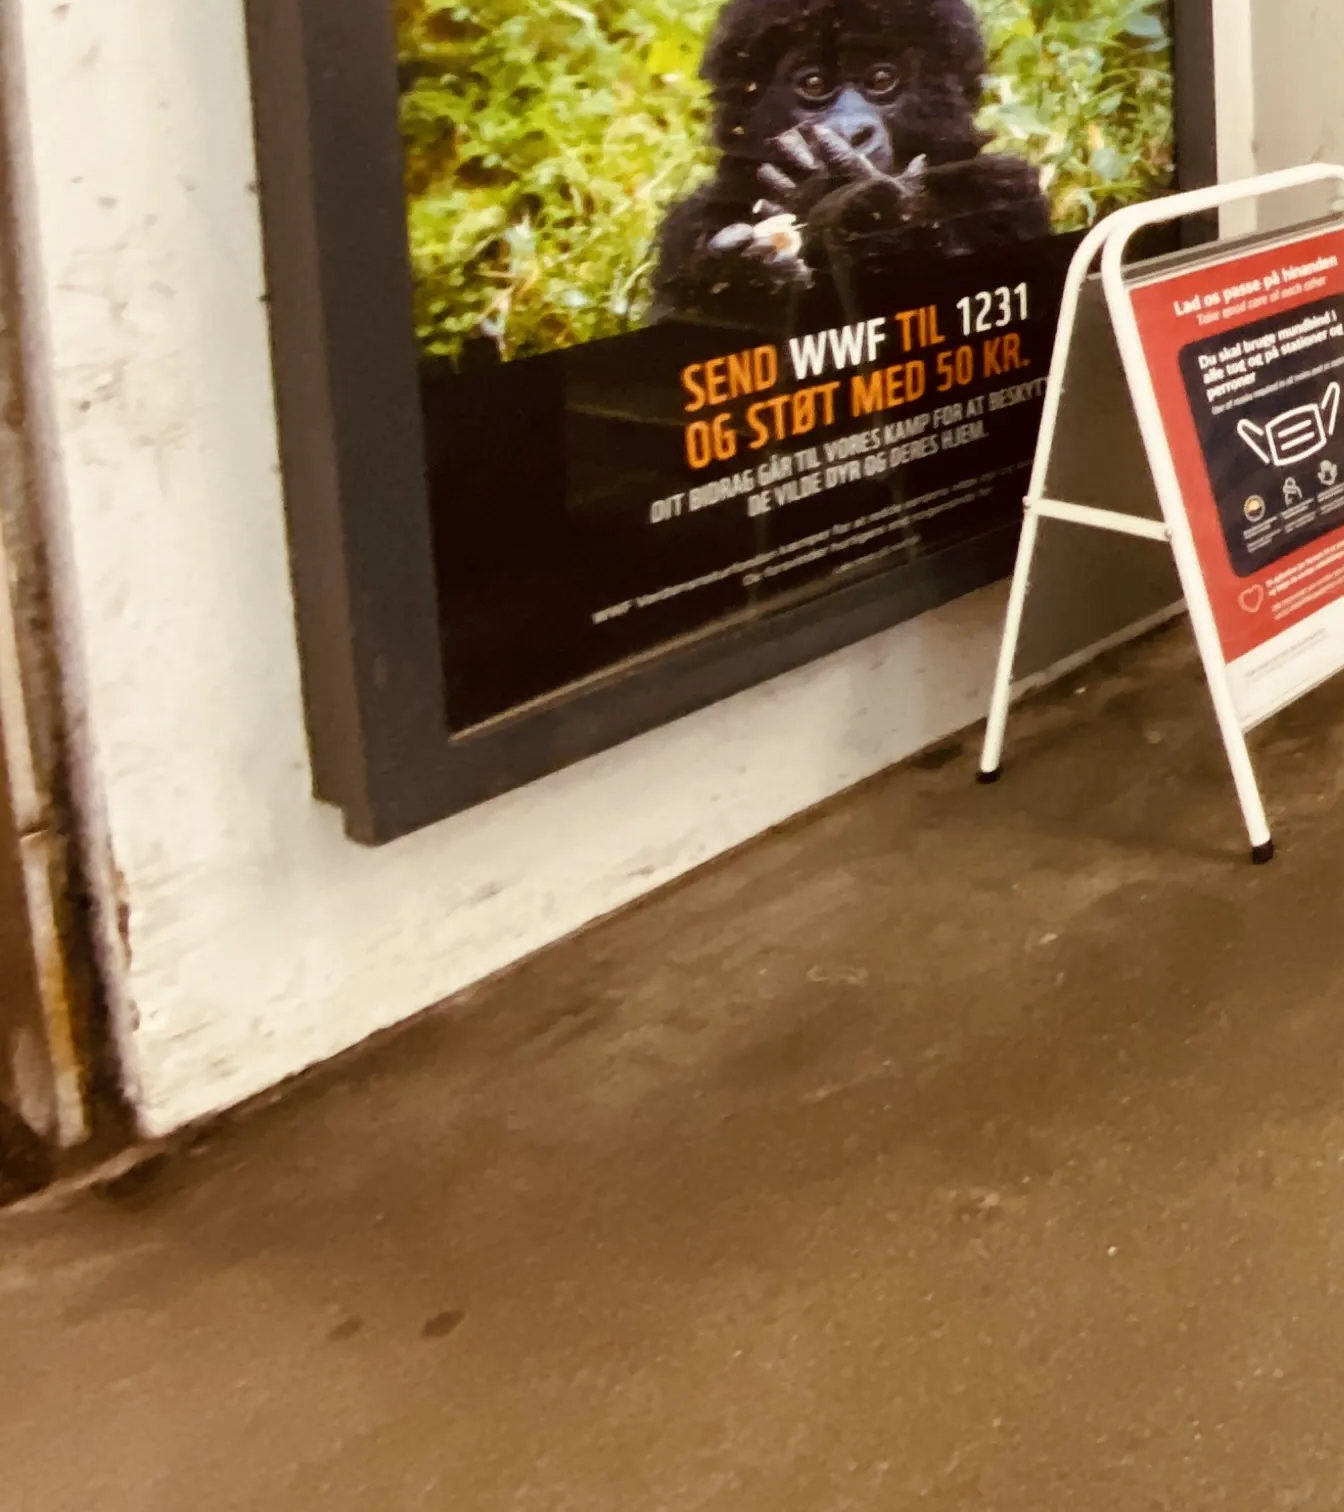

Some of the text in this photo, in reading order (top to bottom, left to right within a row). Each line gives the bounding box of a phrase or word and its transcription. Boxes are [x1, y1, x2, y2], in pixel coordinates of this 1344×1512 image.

[1173, 255, 1339, 317] Lad os passe på hinanden
[681, 282, 1028, 412] SEND WWF TIL 1231
[1198, 309, 1338, 370] Du skal bruge mundbind i
[1203, 323, 1344, 384] alle tog og på stationer og
[685, 332, 1030, 470] OG STØT MED 50 KR.
[1206, 371, 1256, 403] perroner
[650, 377, 1048, 524] DIT BIDRAG GÅR TIL VORES KAMP FOR AT BESKYT
[748, 419, 989, 518] DE VILDE DYR OG DERES HJEM.
